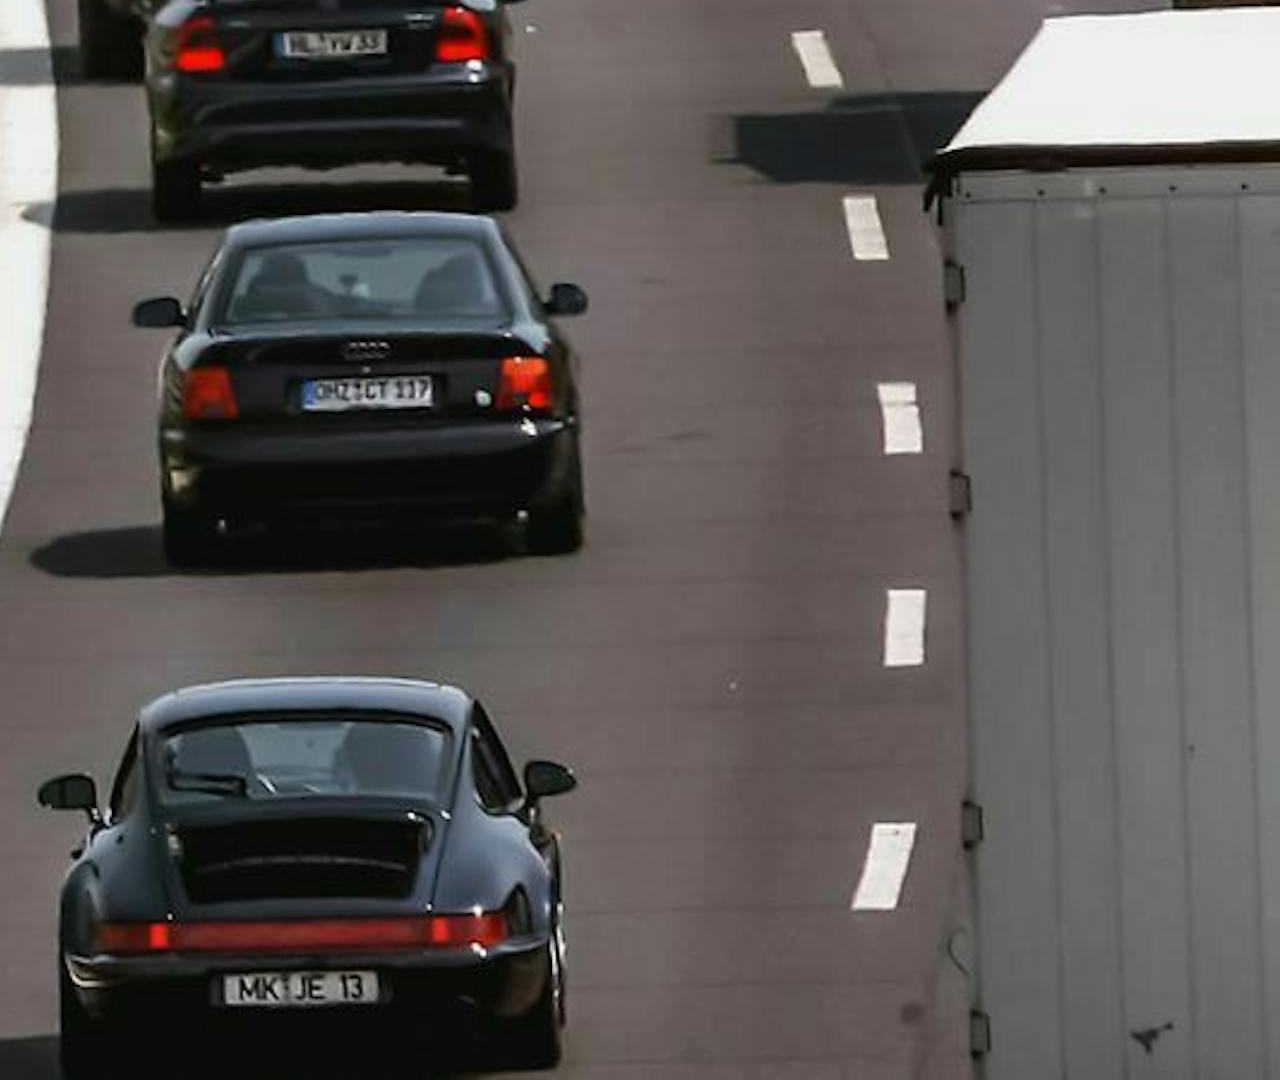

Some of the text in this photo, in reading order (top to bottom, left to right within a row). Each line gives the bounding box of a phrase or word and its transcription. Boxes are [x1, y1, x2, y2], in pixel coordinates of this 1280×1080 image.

[240, 973, 363, 1001] MK JE 13
